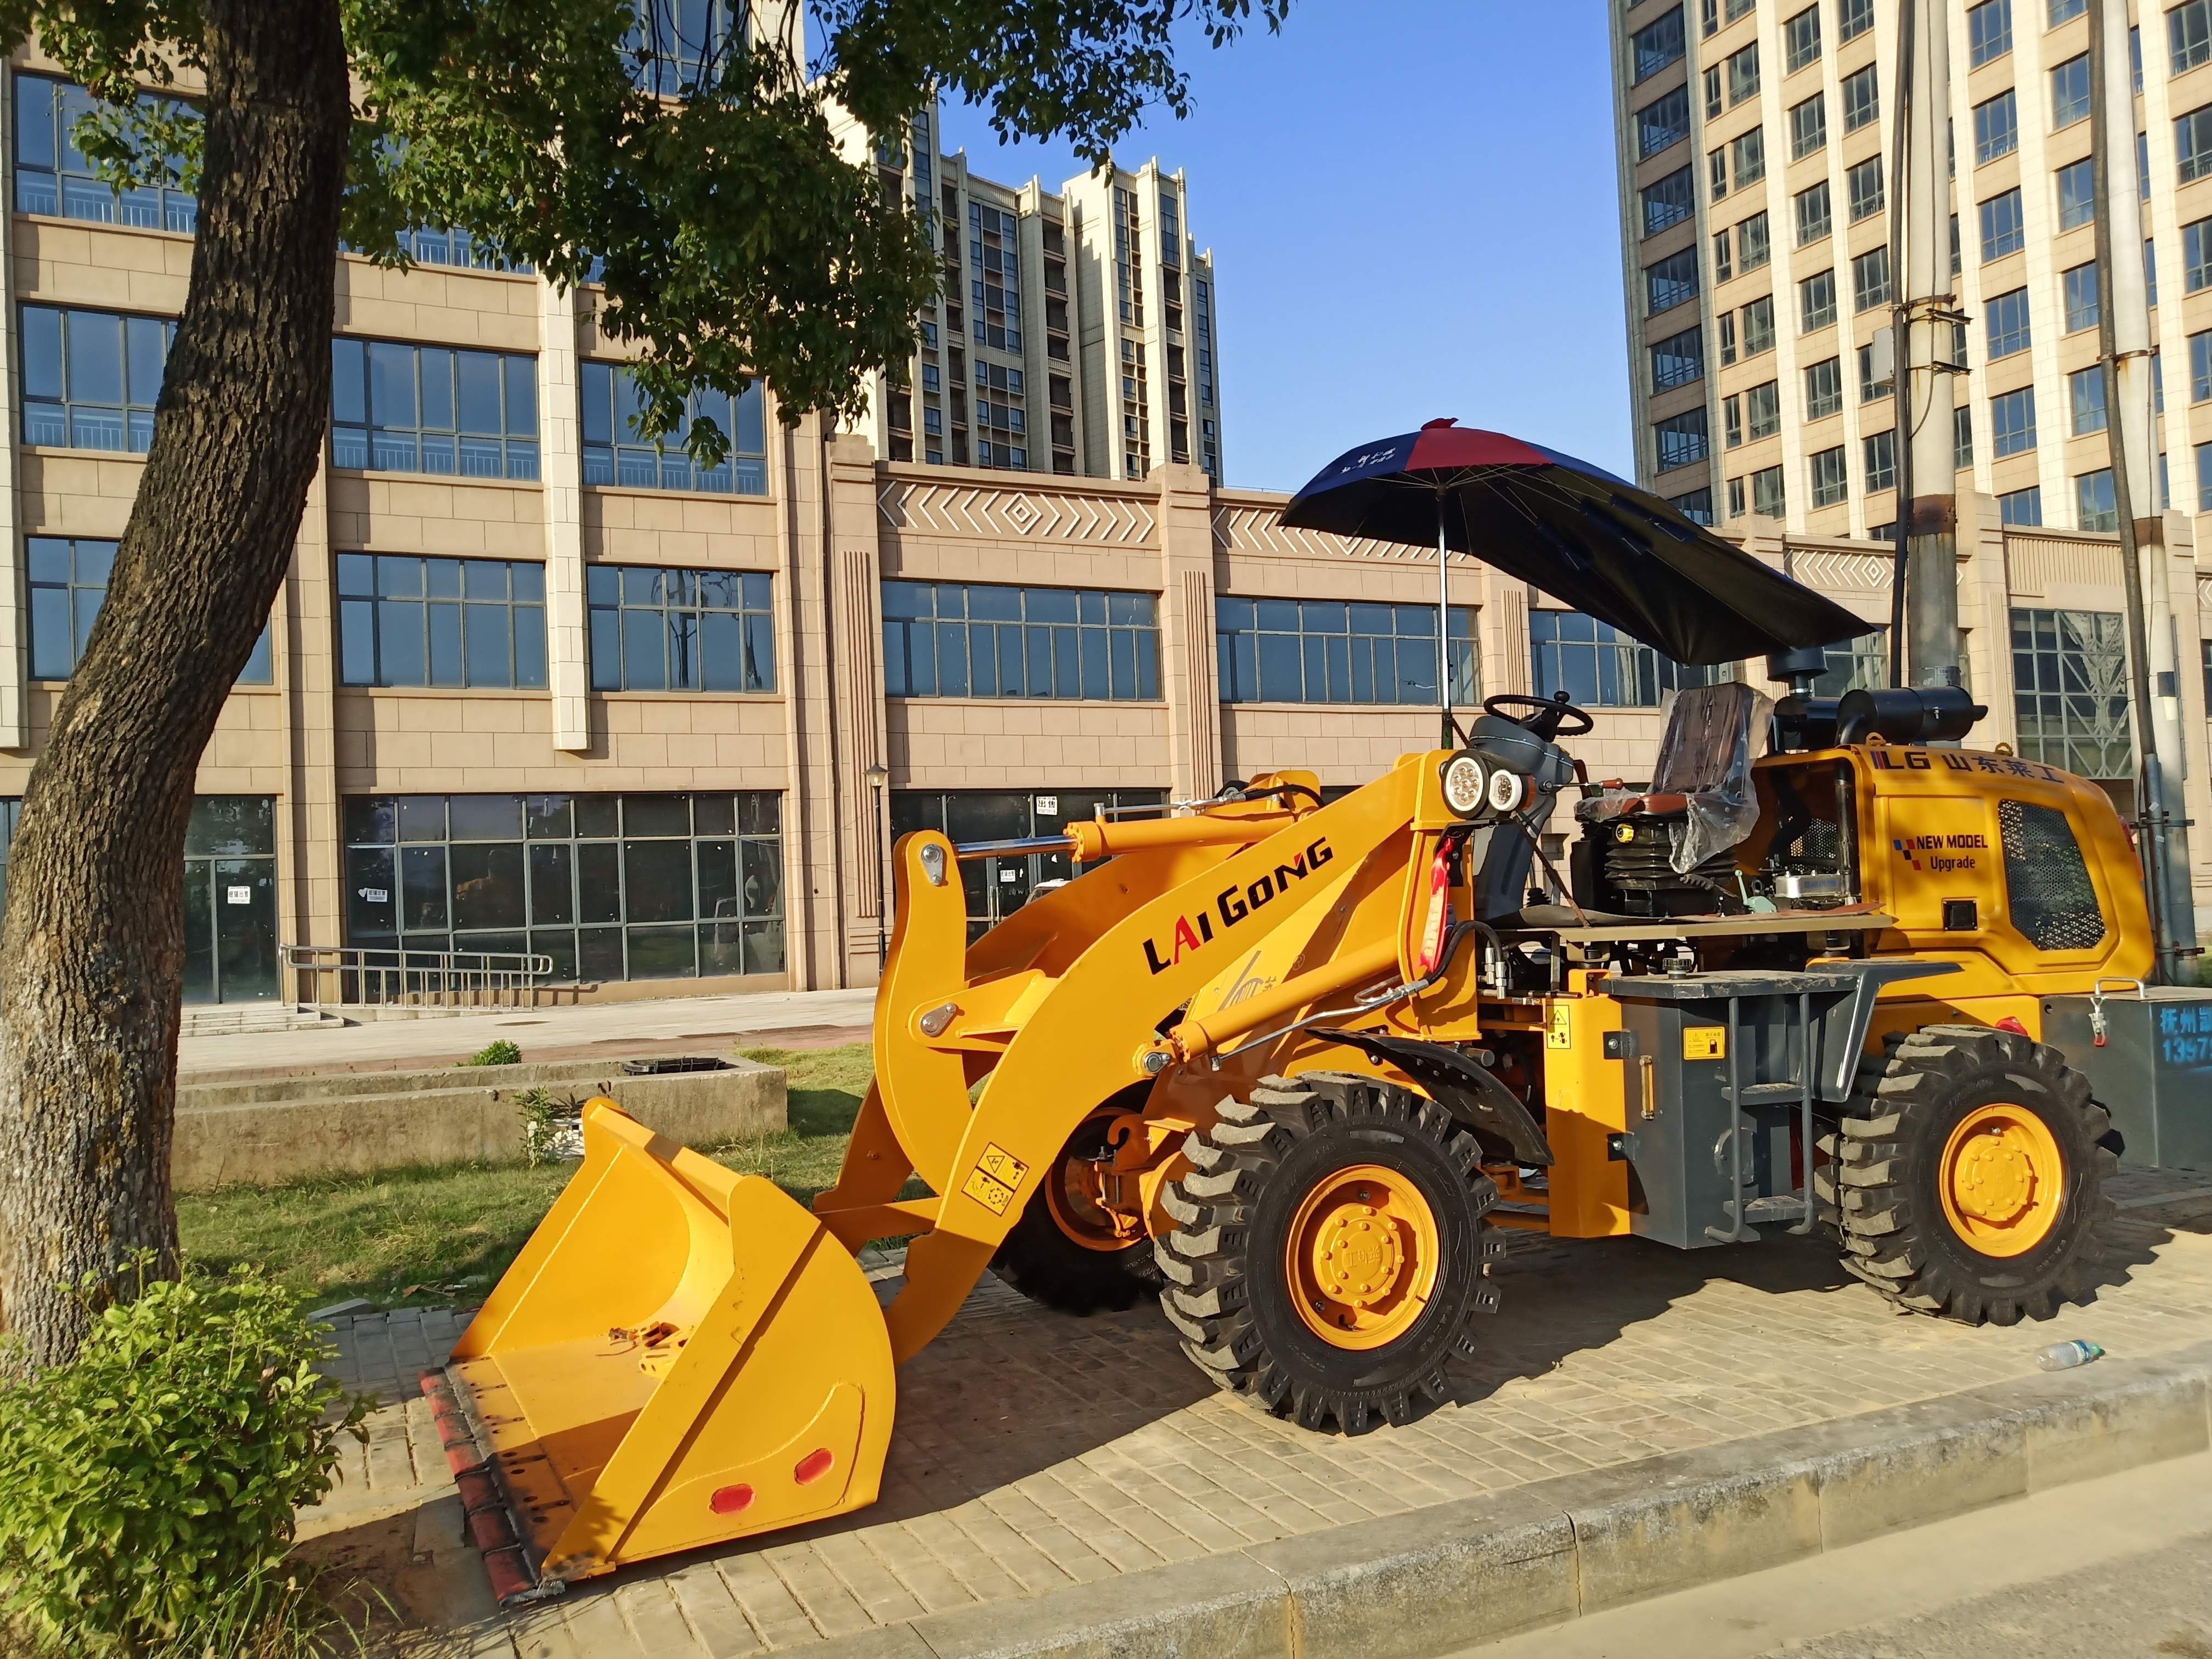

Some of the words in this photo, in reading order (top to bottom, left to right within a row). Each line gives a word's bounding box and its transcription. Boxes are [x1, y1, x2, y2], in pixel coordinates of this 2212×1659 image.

[1881, 751, 1931, 769] LG
[1941, 753, 2065, 784] 山东莱工
[1916, 835, 1943, 850] NEW
[1946, 834, 1988, 849] MODEL
[1930, 856, 1976, 872] Upgrade
[1142, 911, 1214, 975] LAI
[1216, 836, 1334, 928] GONG
[2162, 1037, 2212, 1062] 1397
